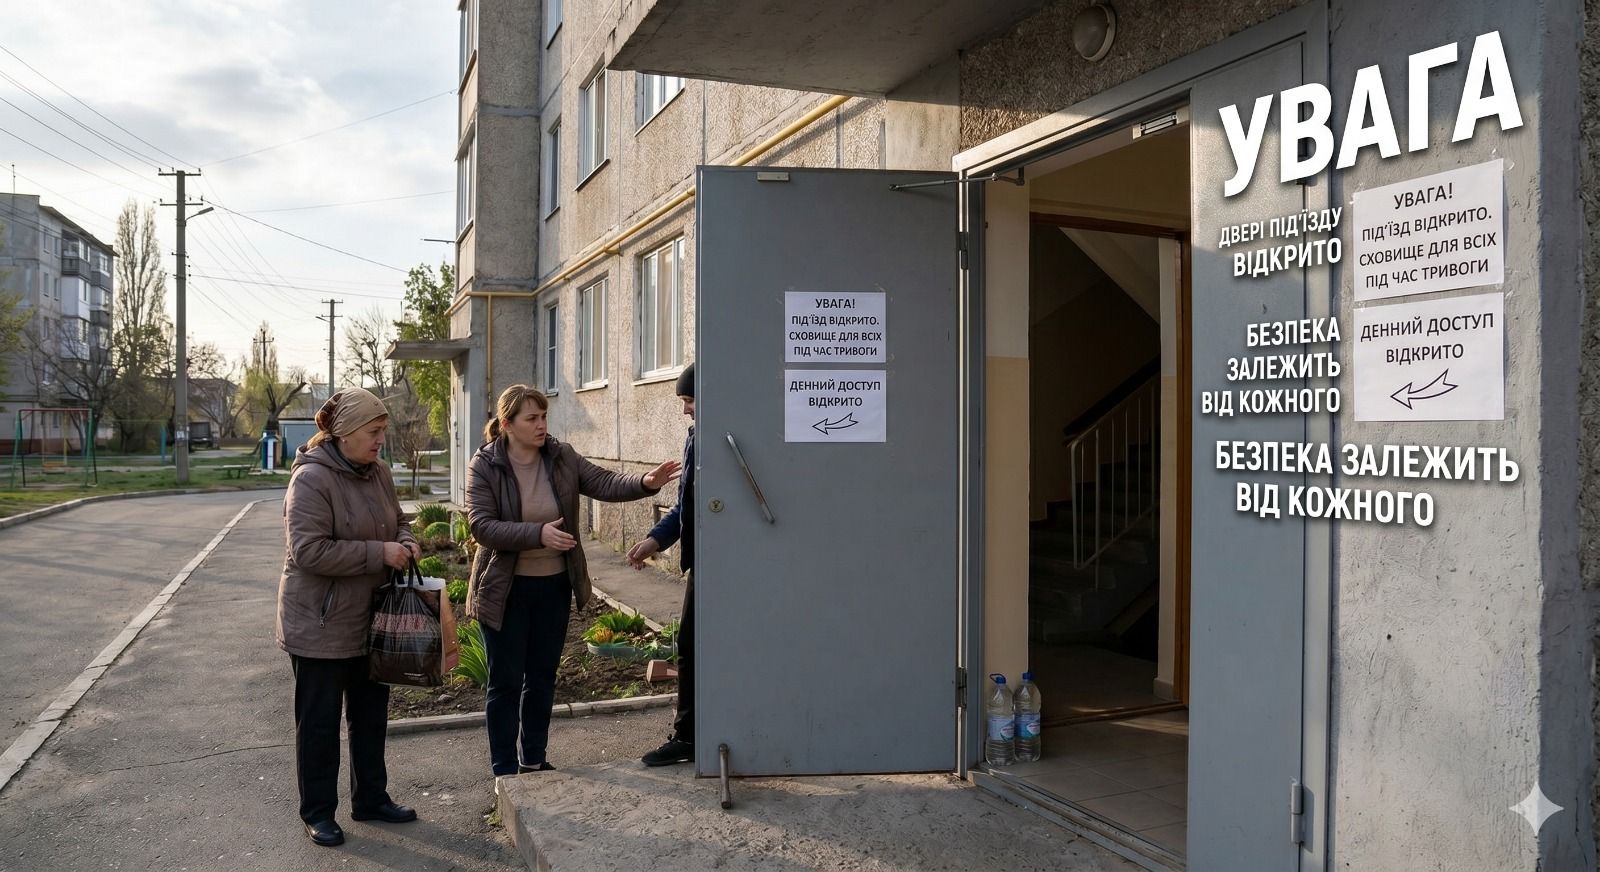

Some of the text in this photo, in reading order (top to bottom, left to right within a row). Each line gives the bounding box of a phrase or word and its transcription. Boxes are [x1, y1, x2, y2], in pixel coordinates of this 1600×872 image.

[1394, 182, 1453, 210] УВАГА!
[1414, 207, 1492, 233] ВІДКРИТО.
[1360, 232, 1497, 266] СХОВИЩЕ ДЛЯ ВСІХ
[1366, 259, 1489, 289] ПІД ЧАС ТРИВОГИ
[815, 298, 855, 309] УВАГА!
[829, 316, 879, 327] ВІДКРИТО.
[1360, 312, 1494, 342] ДЕННИЙ ДОСТУП
[789, 332, 882, 342] СХОВИЩЕ ДЛЯ ВСІХ
[793, 346, 877, 357] ПІД ЧАС ТРИВОГИ
[1385, 343, 1464, 365] ВІДКРИТО
[790, 379, 881, 392] ДЕННИЙ ДОСТУП
[808, 397, 863, 408] ВІДКРИТО
